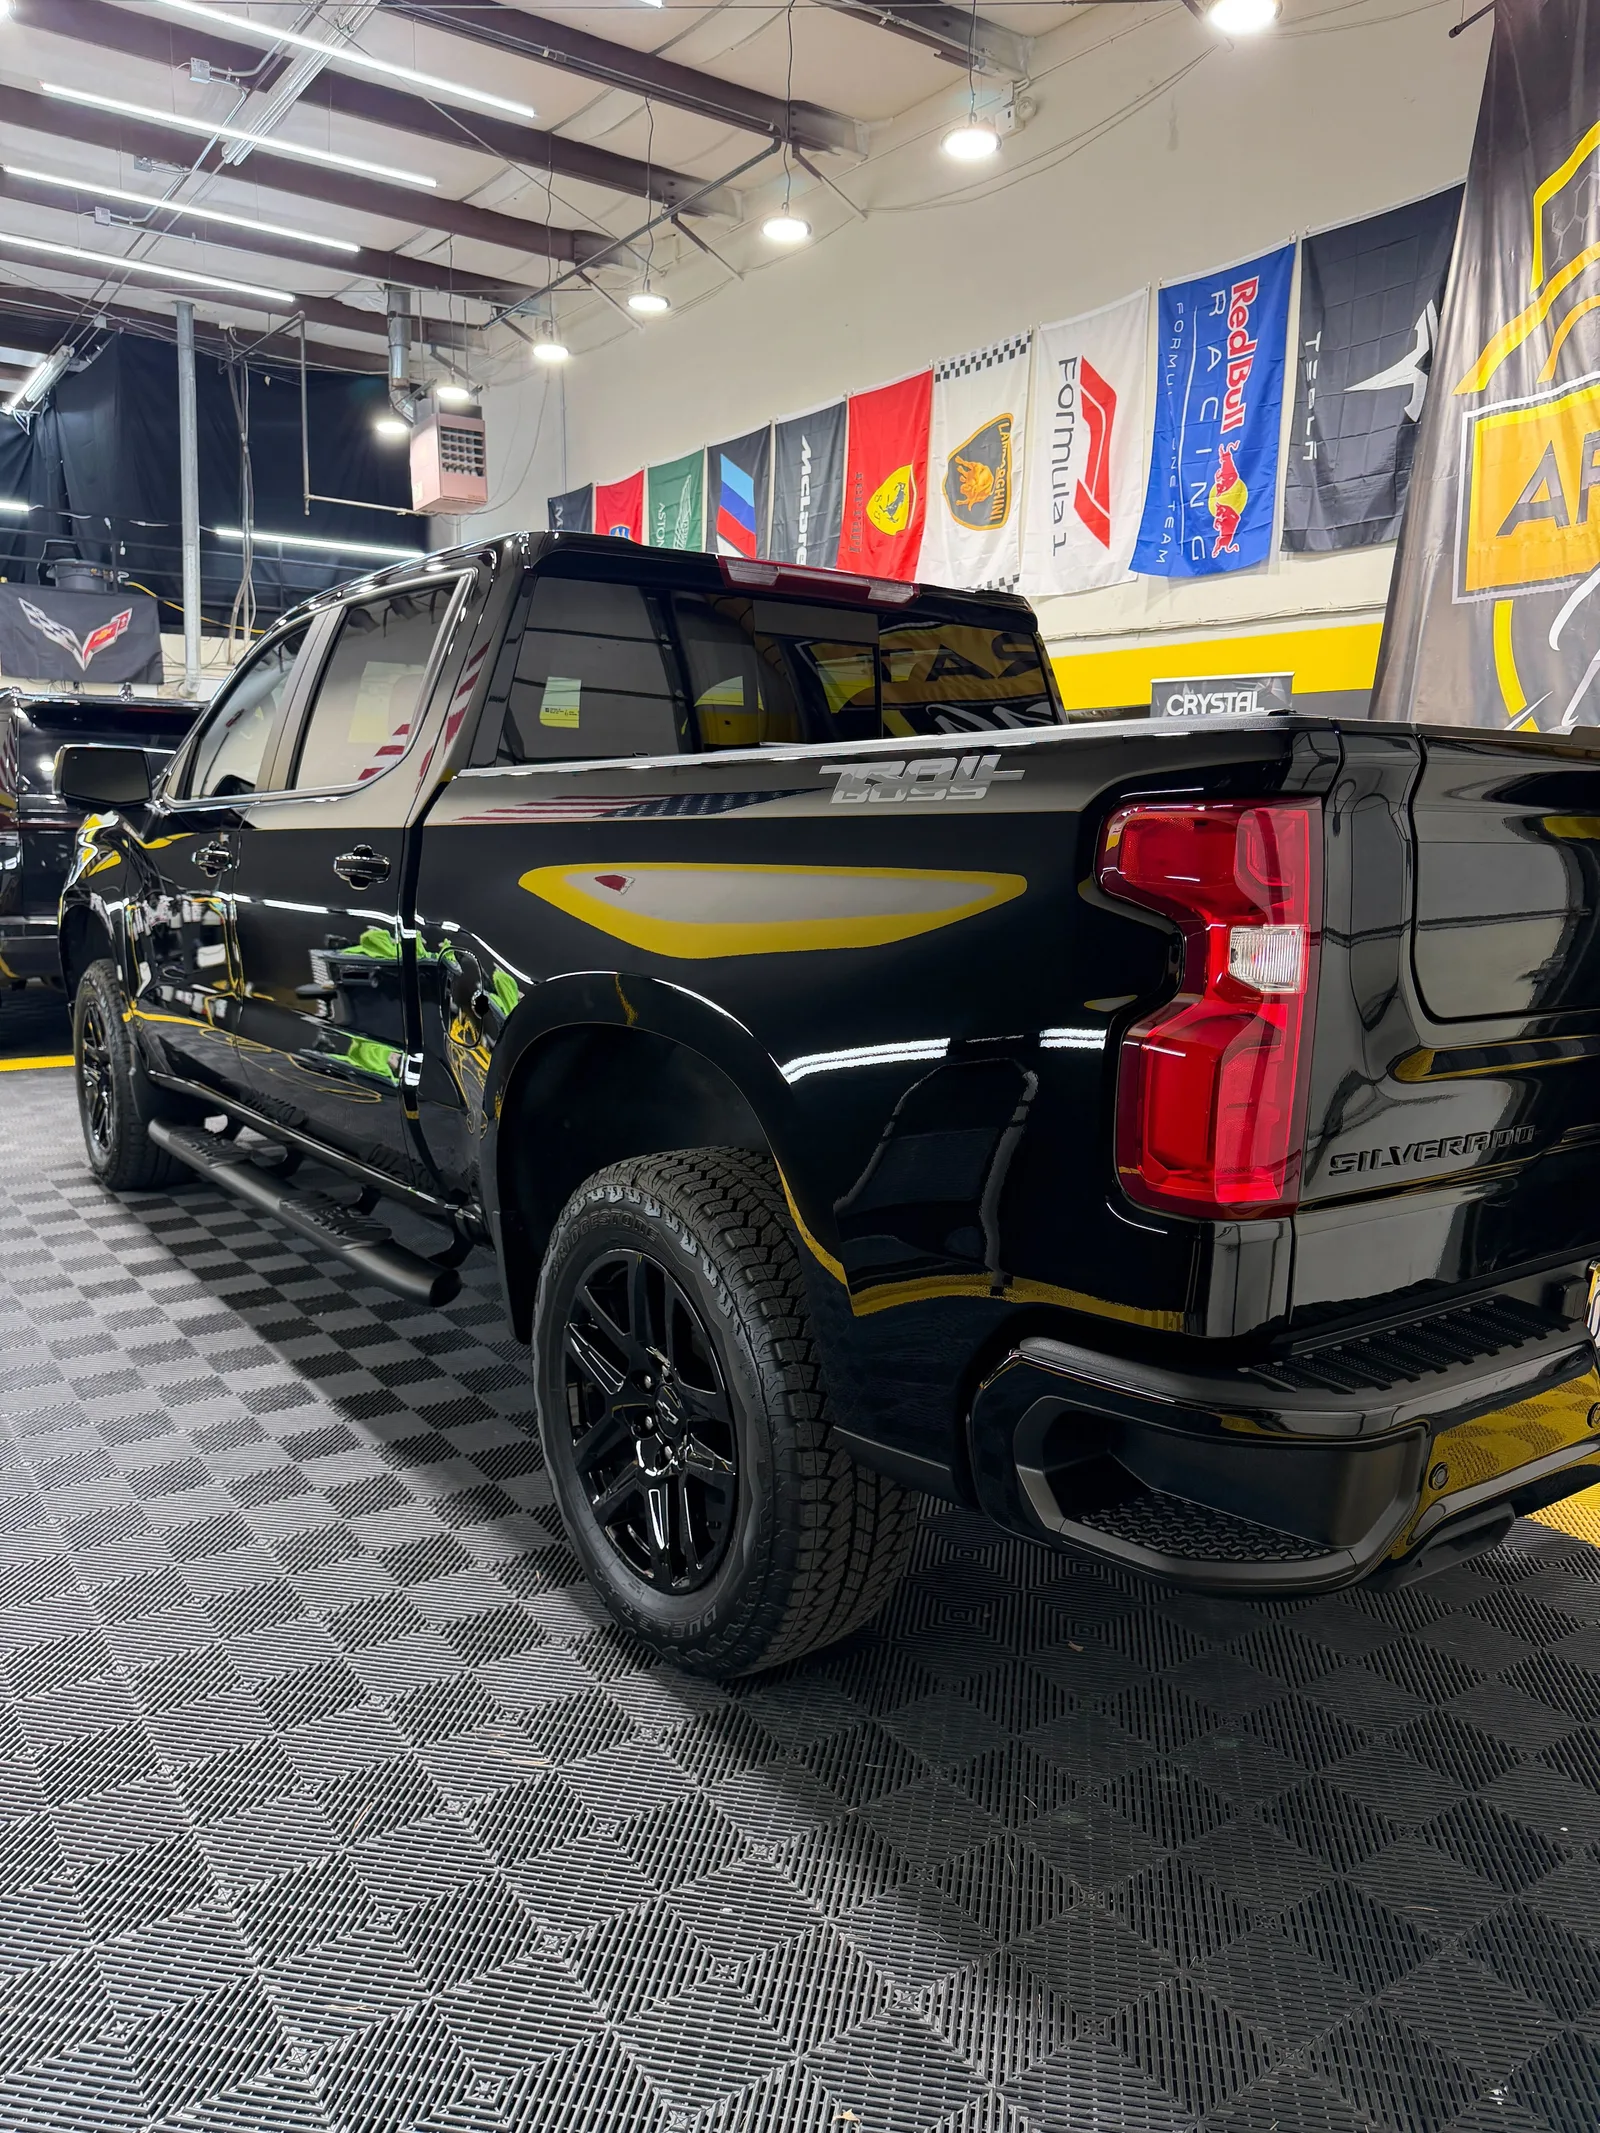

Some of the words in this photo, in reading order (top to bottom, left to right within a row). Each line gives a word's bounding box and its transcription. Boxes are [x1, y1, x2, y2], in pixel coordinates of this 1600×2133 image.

[1166, 302, 1184, 398] FORMU
[1190, 289, 1227, 561] RACING
[1302, 331, 1322, 460] TESLA
[989, 422, 1010, 521] LAMRGHINI
[1052, 356, 1078, 525] Formula
[1053, 532, 1067, 557] 1
[1156, 500, 1176, 563] TEAM
[1166, 691, 1265, 716] CRYSTAL
[818, 754, 1026, 784] TRAIL
[830, 782, 988, 804] BOSS
[1328, 1124, 1536, 1177] SILVERADO
